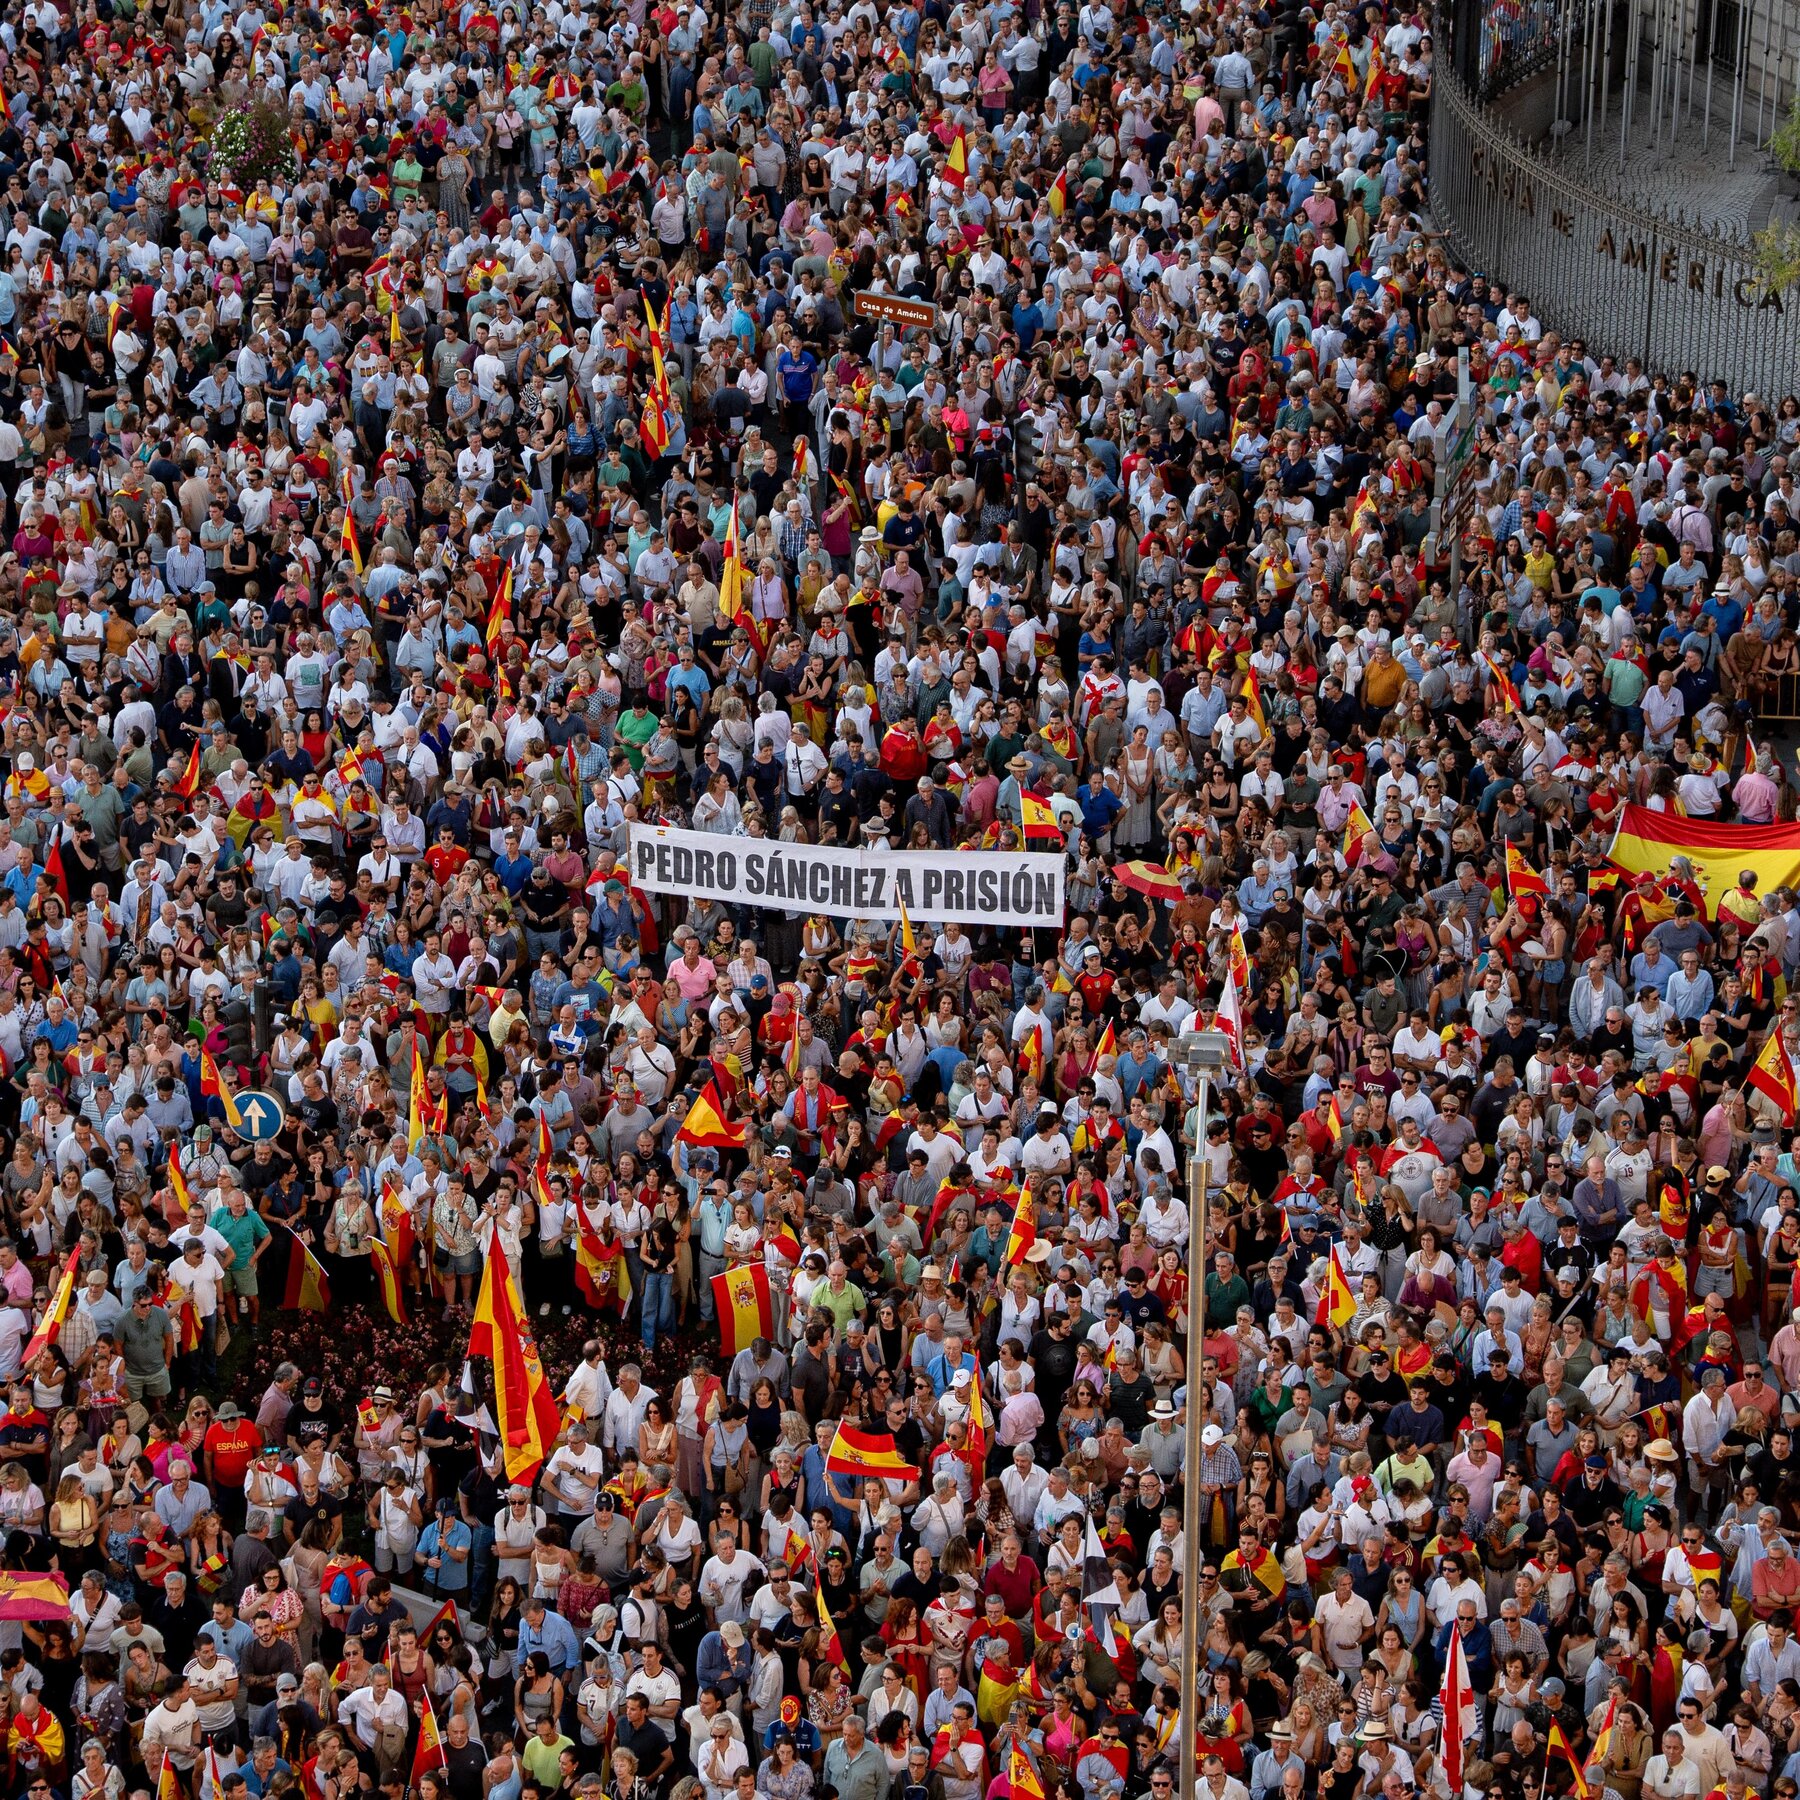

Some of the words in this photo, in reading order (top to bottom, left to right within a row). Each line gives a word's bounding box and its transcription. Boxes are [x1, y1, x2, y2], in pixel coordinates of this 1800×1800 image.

[1472, 147, 1535, 218] CASA
[1551, 207, 1575, 238] DE
[1596, 227, 1784, 315] AMÉRICA
[861, 301, 880, 311] Casa
[884, 305, 894, 314] de
[897, 308, 928, 321] América
[434, 858, 440, 868] 5
[637, 841, 737, 891] PEDRO
[745, 850, 886, 908] SÁNCHEZ
[893, 868, 915, 908] A
[923, 863, 1055, 916] PRISIÓN
[1096, 992, 1102, 1002] 7
[1624, 1166, 1634, 1178] 19
[216, 1439, 248, 1451] ESPAÑA
[589, 1699, 596, 1712] 7
